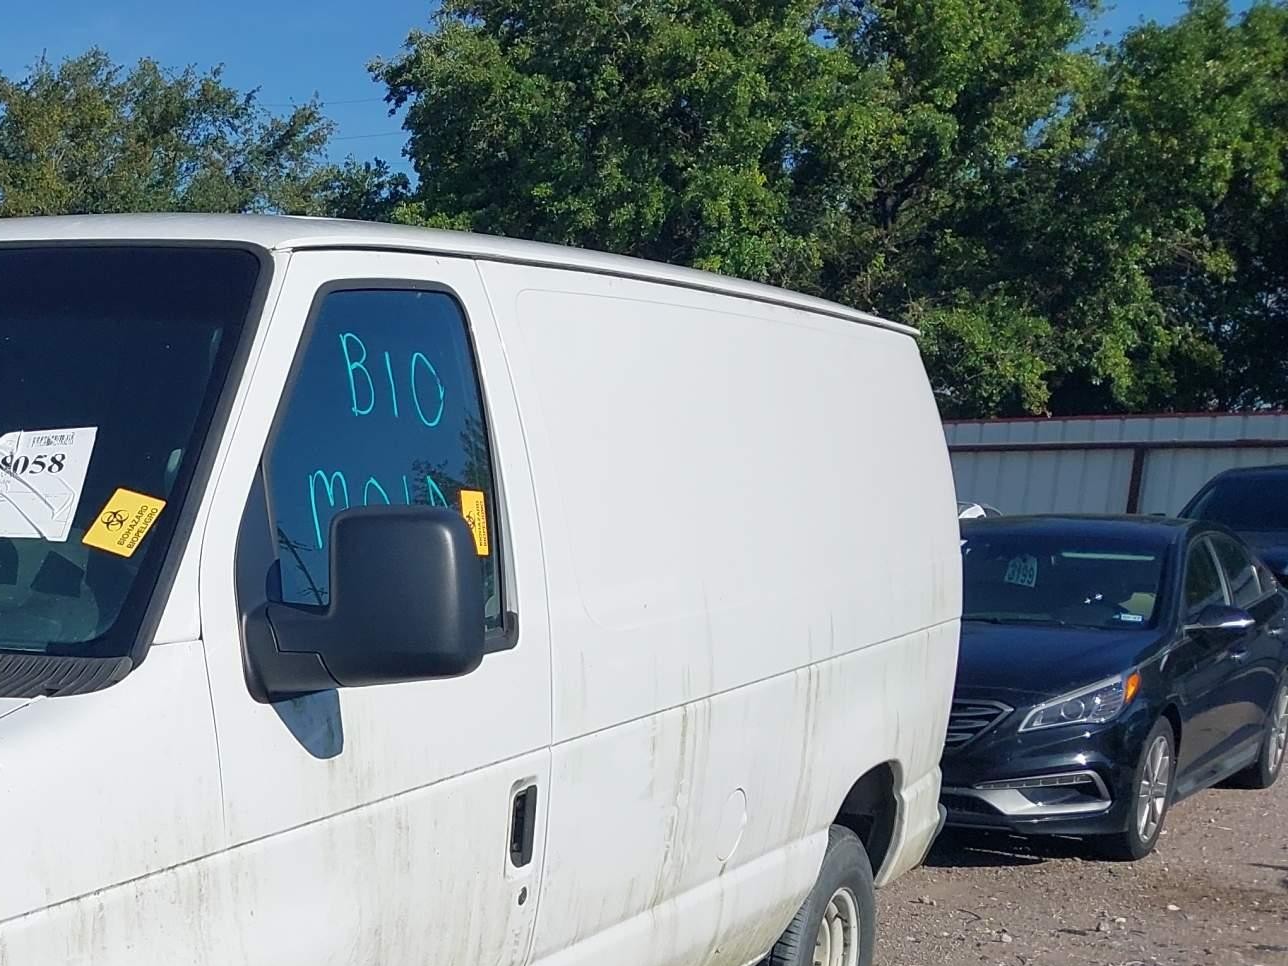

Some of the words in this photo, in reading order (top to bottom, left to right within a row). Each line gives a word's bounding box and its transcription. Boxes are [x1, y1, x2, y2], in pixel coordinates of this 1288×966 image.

[339, 332, 445, 427] BIO
[117, 505, 149, 546] BIOHAZARD
[127, 507, 159, 549] BIOPELIGRO
